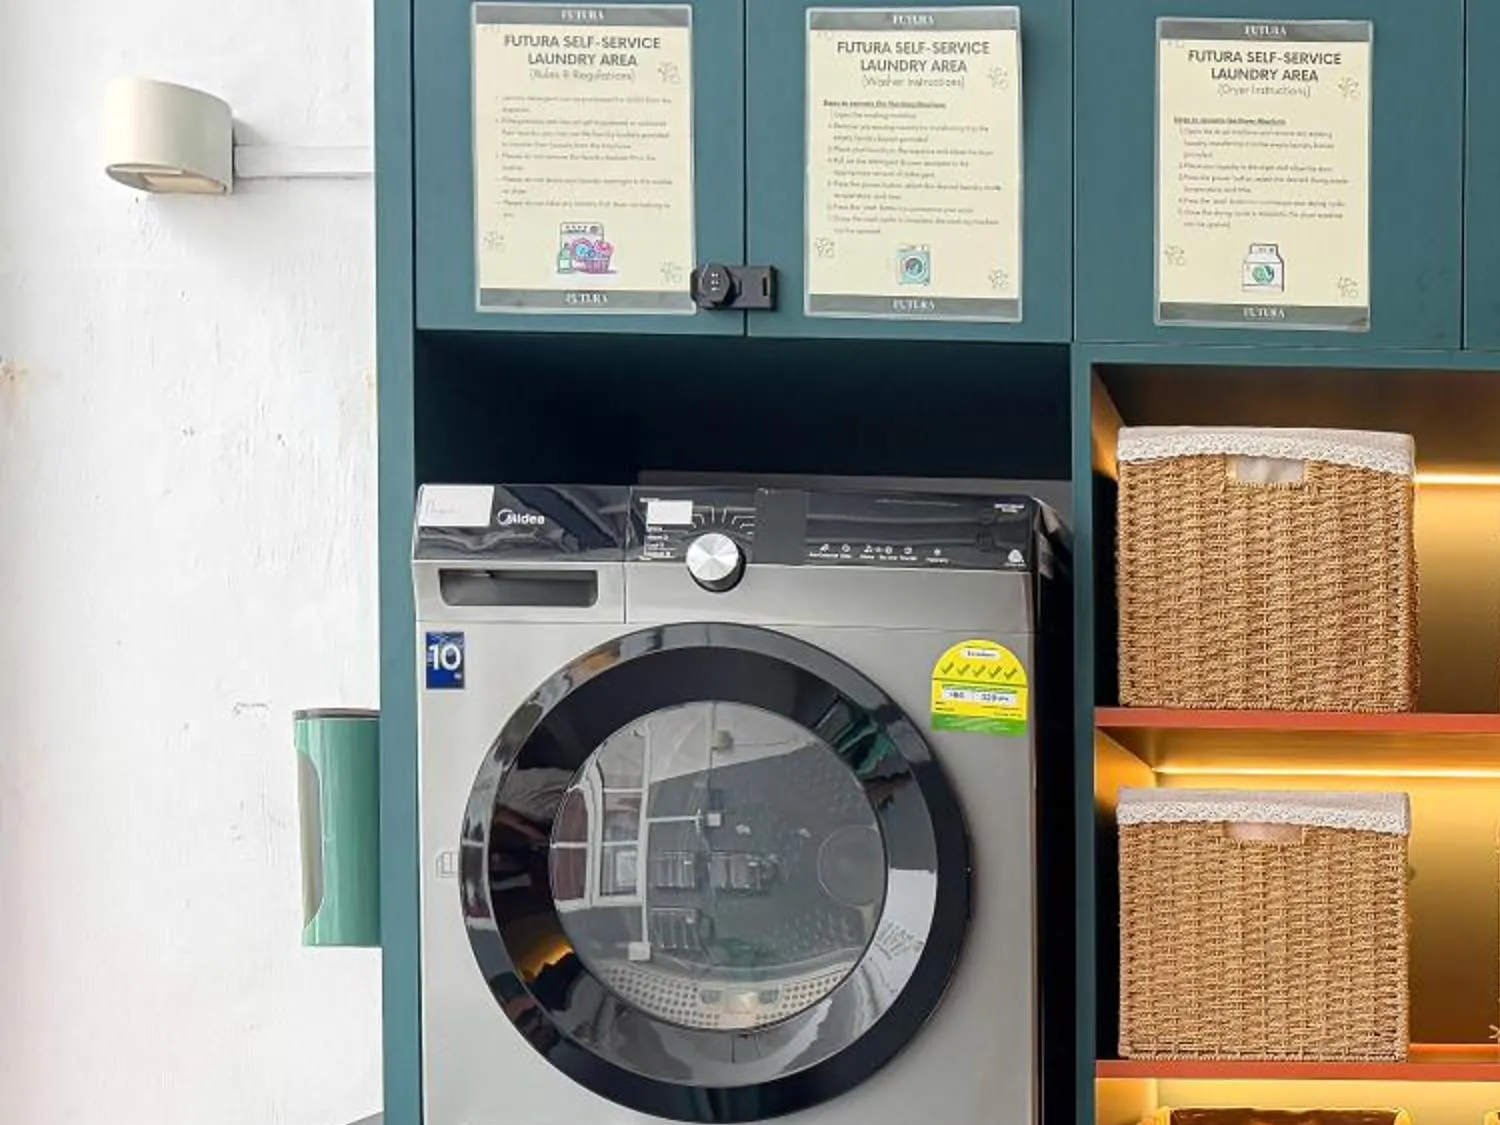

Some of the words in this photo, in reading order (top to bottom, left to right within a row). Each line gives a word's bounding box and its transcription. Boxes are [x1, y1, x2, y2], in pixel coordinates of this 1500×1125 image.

[893, 15, 935, 25] FUTURA
[1245, 25, 1287, 36] FUTURA
[504, 35, 560, 47] FUTURA
[563, 35, 661, 49] SELF-SERVICE
[838, 42, 891, 54] FUTURA
[895, 42, 991, 55] SELF-SERVICE
[528, 53, 596, 65] LAUNDRY
[600, 54, 638, 66] AREA
[1188, 50, 1242, 63] FUTURA
[1247, 51, 1342, 65] SELF-SERVICE
[861, 59, 927, 72] LAUNDRY
[931, 60, 968, 73] AREA
[1211, 68, 1278, 81] LAUNDRY
[1281, 69, 1319, 82] AREA
[502, 511, 545, 525] Midea
[429, 644, 462, 671] 10
